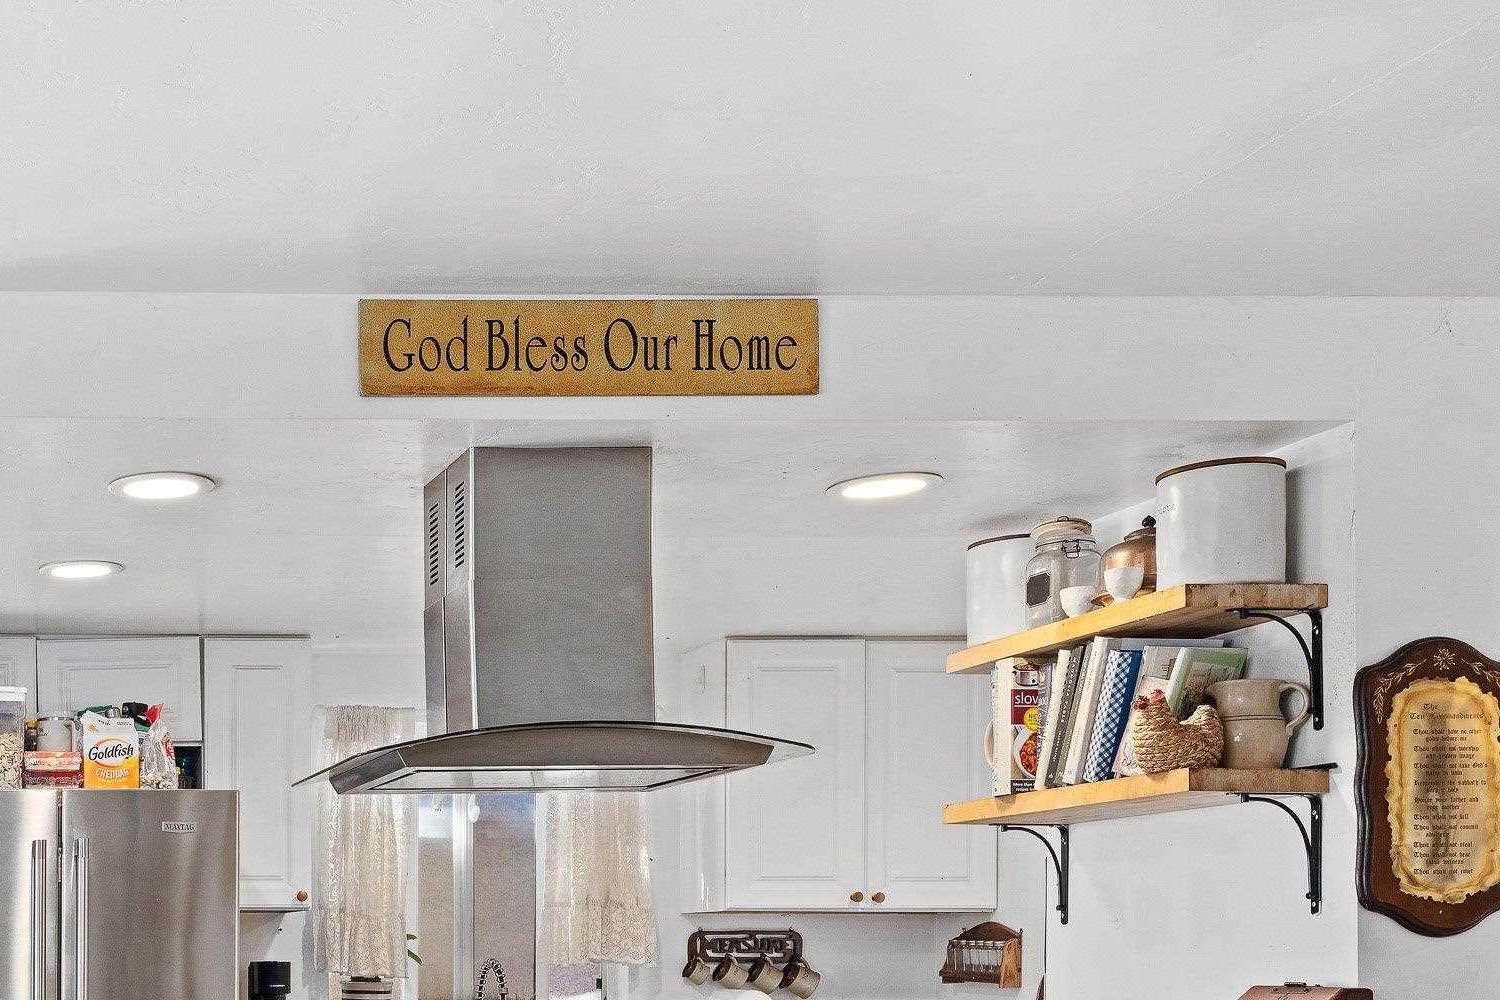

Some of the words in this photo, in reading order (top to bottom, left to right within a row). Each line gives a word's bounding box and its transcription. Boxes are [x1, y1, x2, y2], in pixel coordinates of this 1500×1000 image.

[382, 314, 469, 372] God
[484, 314, 589, 372] Bless
[603, 318, 678, 372] Our
[692, 319, 798, 372] Home
[88, 743, 134, 761] Goldfish
